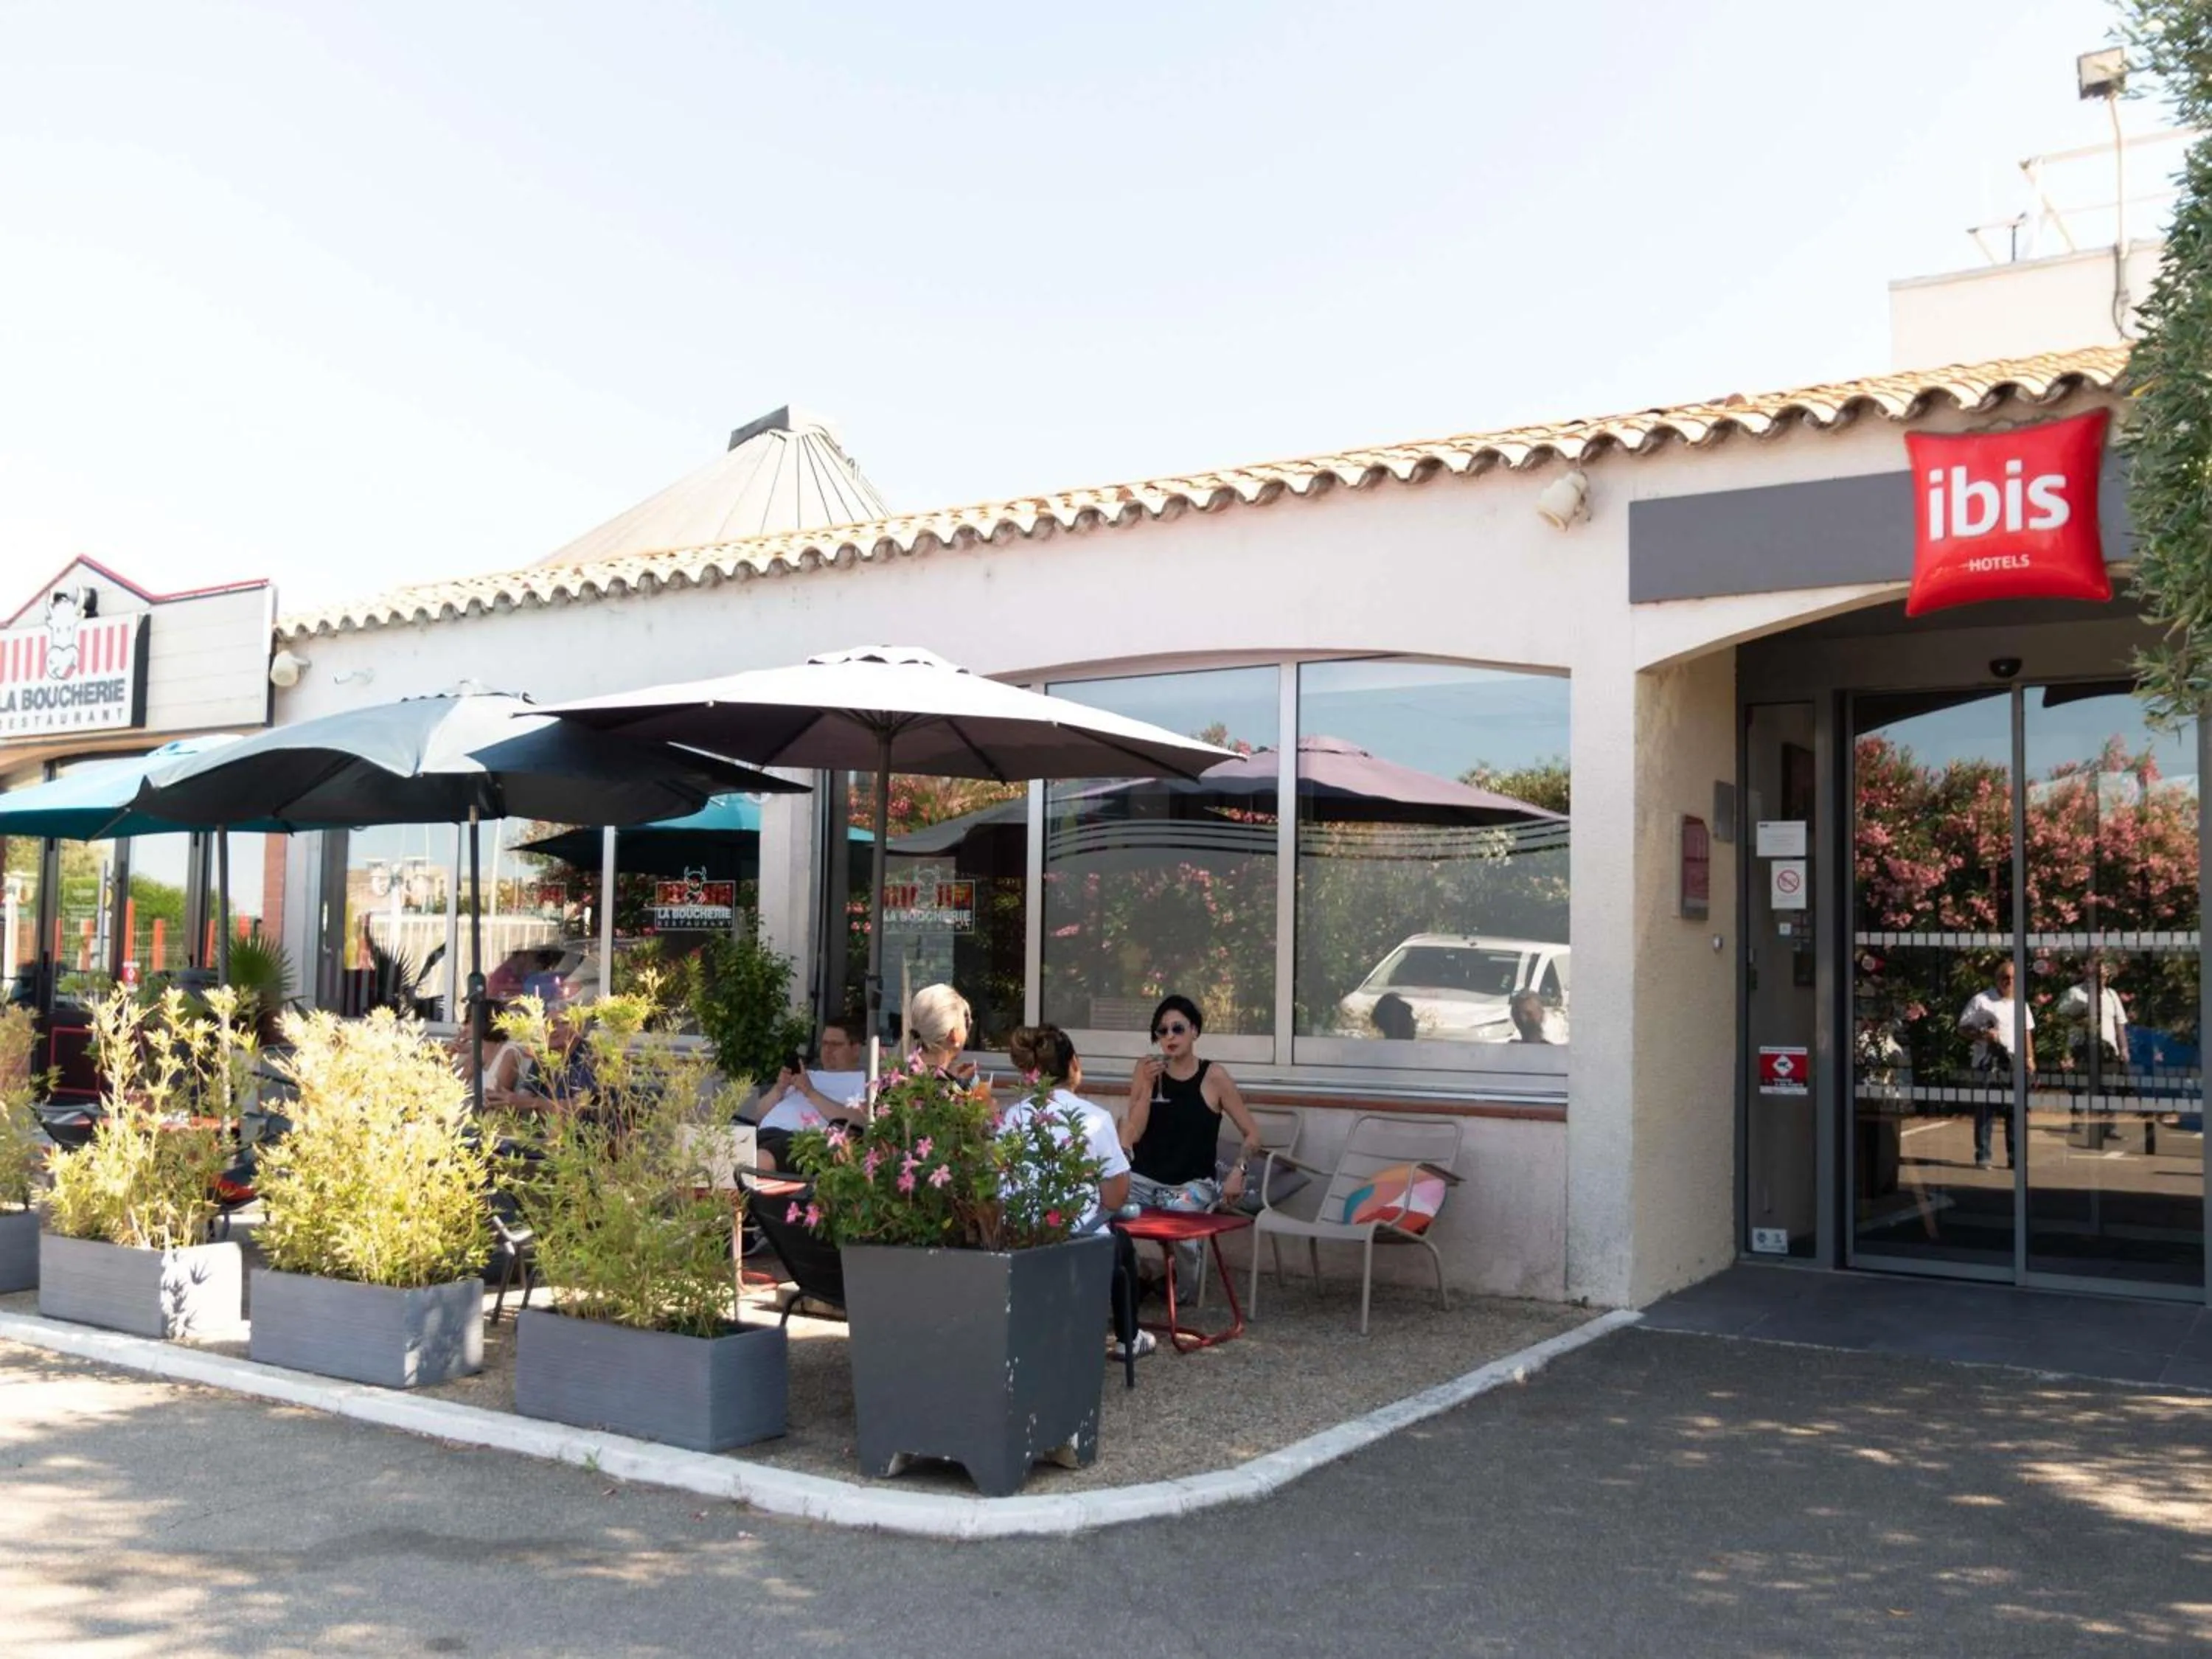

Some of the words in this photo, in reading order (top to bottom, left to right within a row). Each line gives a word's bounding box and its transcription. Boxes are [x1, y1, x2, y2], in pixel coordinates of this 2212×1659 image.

[1928, 459, 2071, 541] ibis
[1969, 554, 2030, 571] HOTELS
[21, 678, 125, 710] BOUCHERIE
[657, 908, 670, 919] LA
[672, 908, 732, 920] BOUCHERIE
